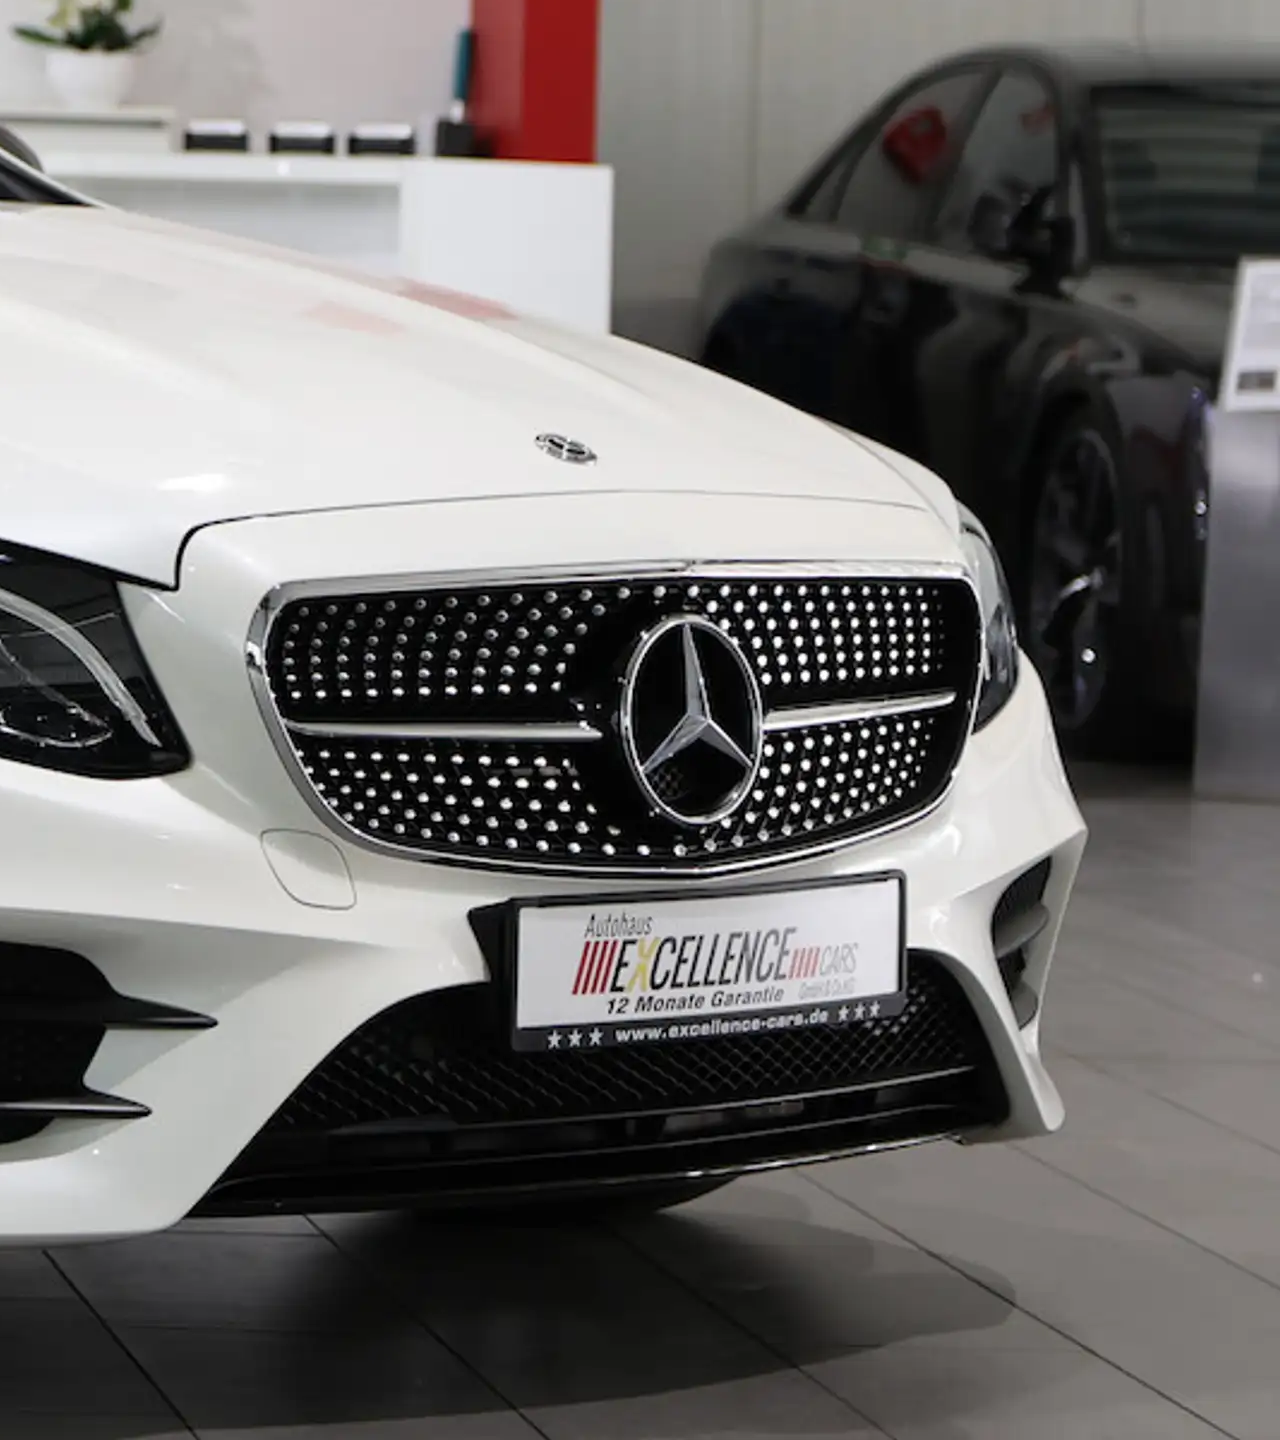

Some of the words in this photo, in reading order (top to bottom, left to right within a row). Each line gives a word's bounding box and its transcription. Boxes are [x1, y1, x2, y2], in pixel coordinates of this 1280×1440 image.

[584, 912, 654, 938] Autohaus
[609, 926, 798, 993] EXCELLENCE
[819, 942, 859, 976] CARS
[606, 995, 628, 1015] 12
[633, 993, 705, 1014] Monate
[710, 986, 785, 1009] Garantie
[615, 1008, 829, 1043] www.excellence-cars.de
